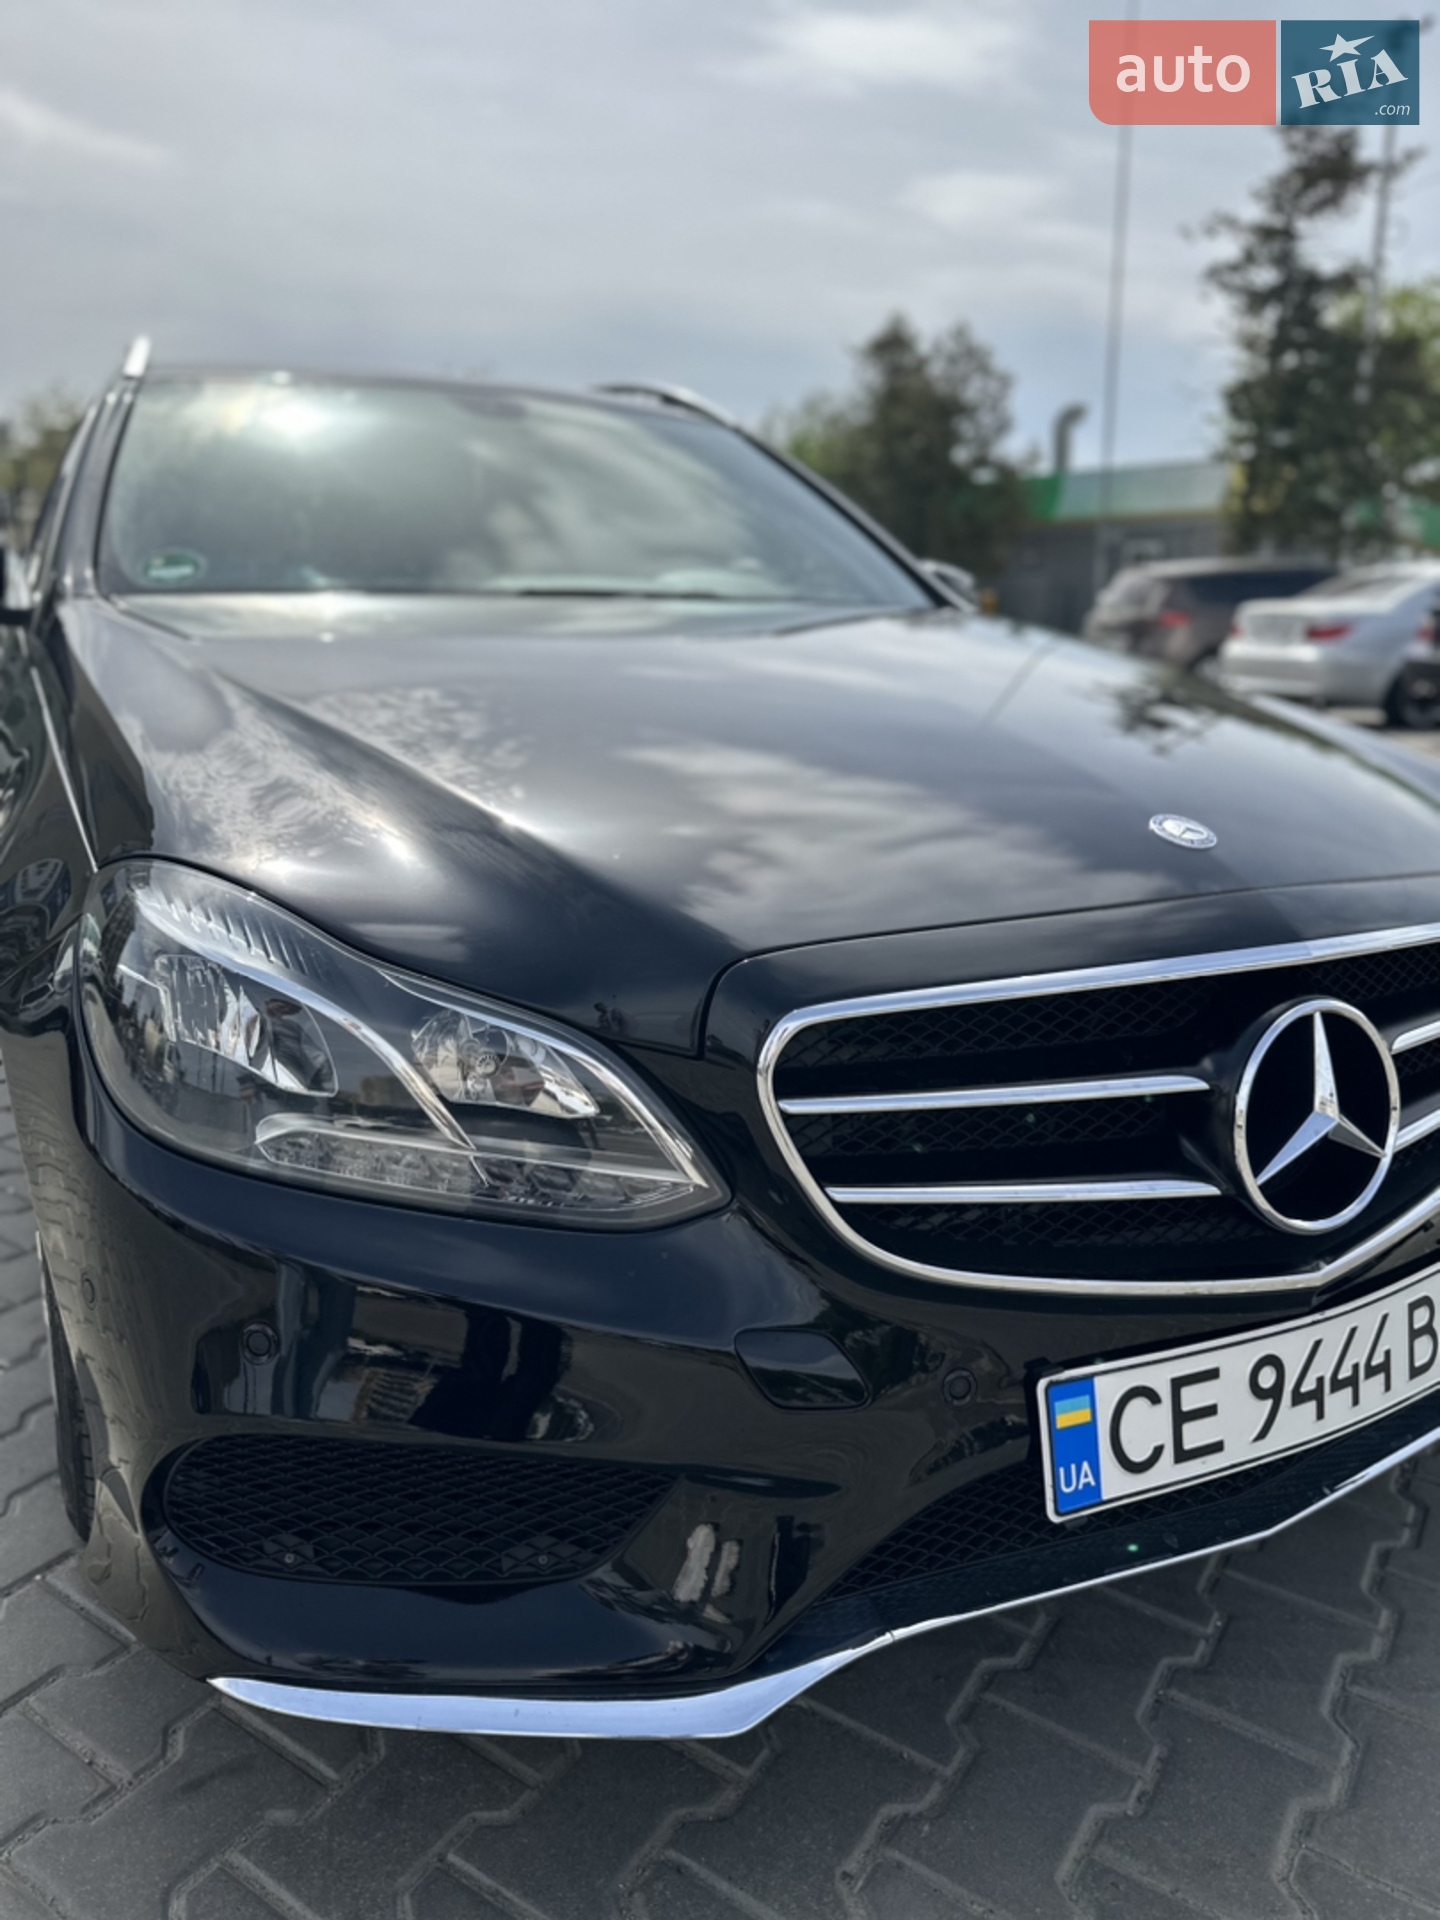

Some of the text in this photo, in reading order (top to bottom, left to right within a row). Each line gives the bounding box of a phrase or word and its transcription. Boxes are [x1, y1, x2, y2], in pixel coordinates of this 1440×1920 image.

[1109, 1366, 1225, 1475] CE
[1248, 1312, 1392, 1444] 9444
[1059, 1461, 1096, 1494] UA
